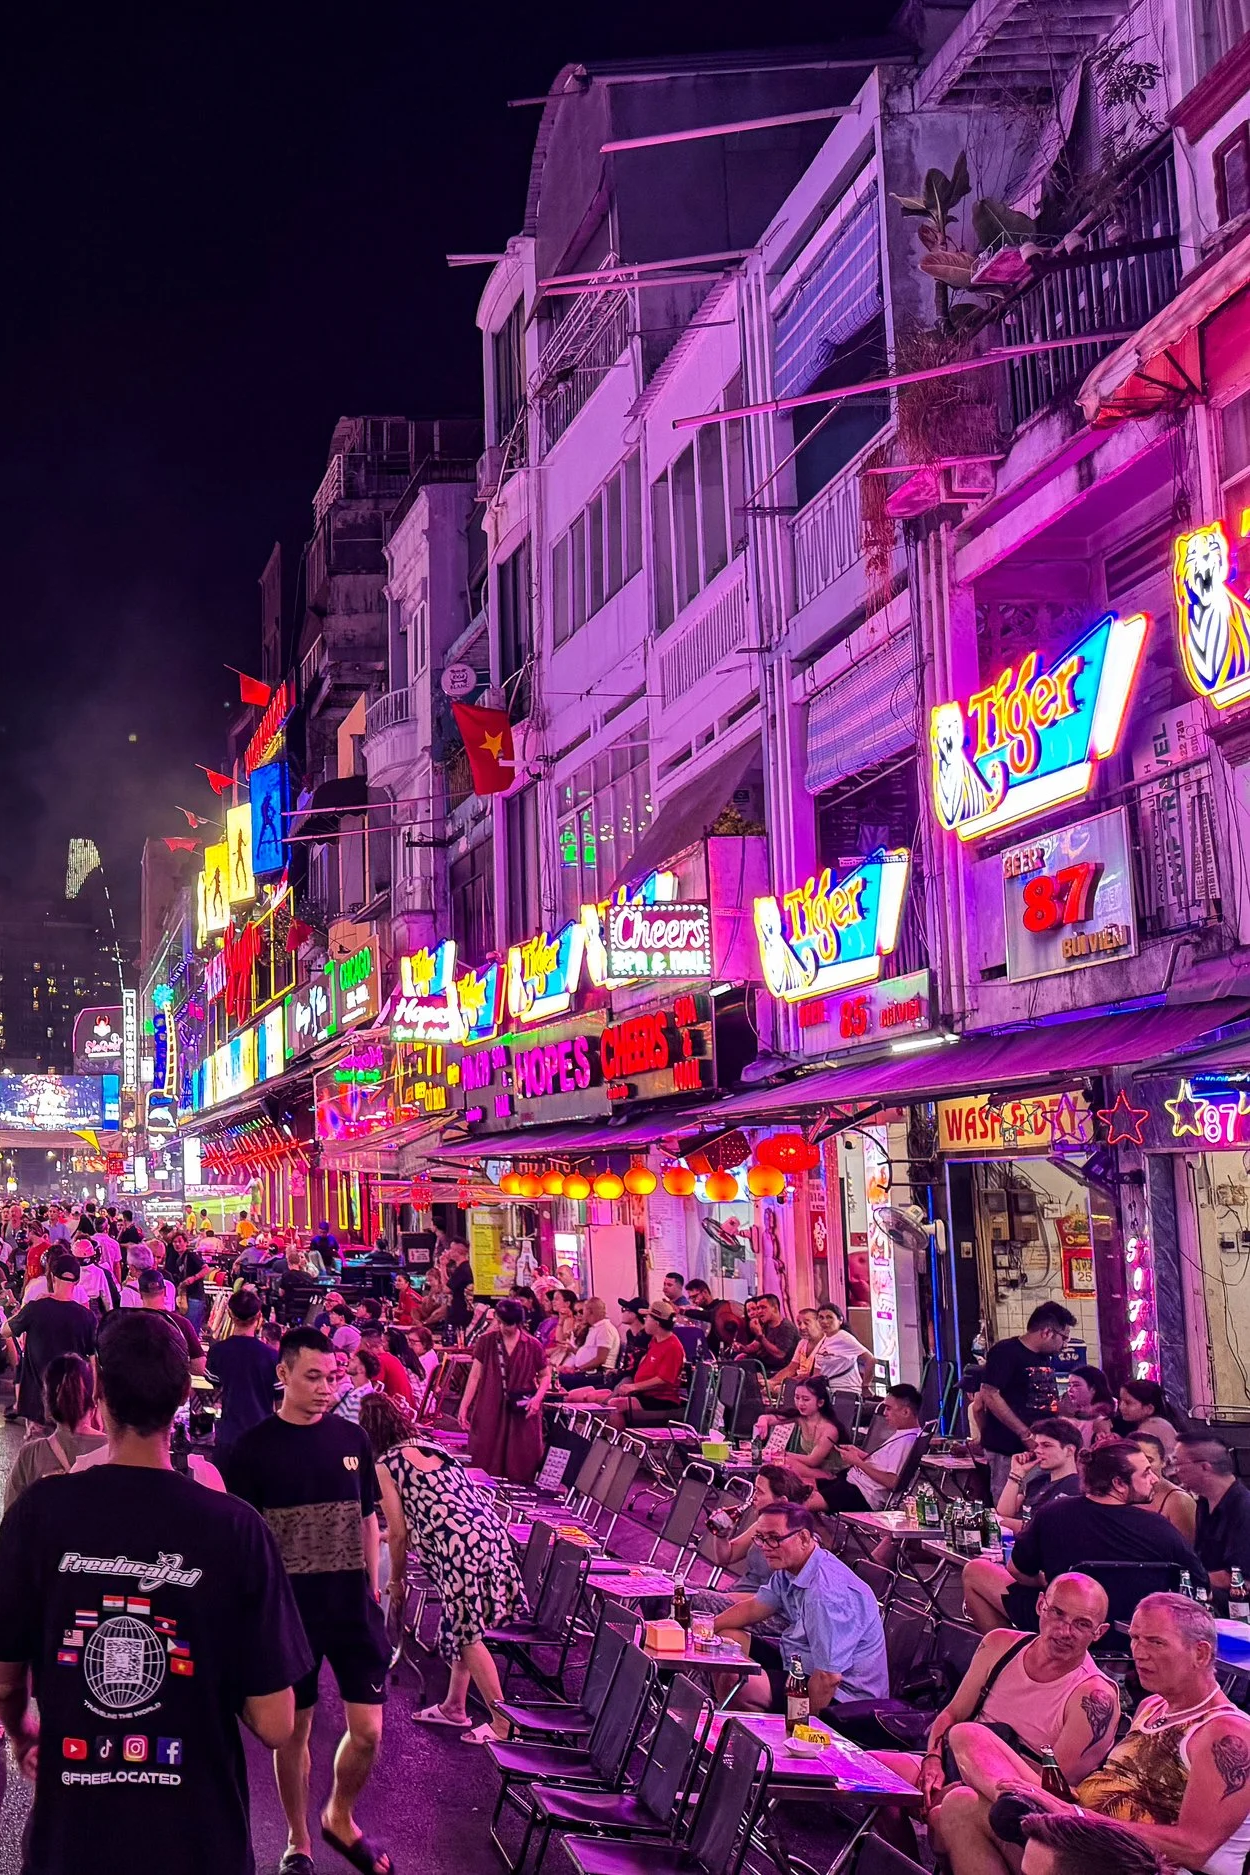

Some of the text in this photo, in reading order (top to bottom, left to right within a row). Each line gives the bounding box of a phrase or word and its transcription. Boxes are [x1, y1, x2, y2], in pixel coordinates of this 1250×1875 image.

[967, 652, 1081, 776] Tiger
[1003, 847, 1044, 880] BEER
[783, 867, 864, 962] Tiger
[1022, 861, 1094, 933] 87
[615, 908, 706, 950] Cheers
[339, 946, 371, 991] CHICAGO
[521, 931, 561, 995] Tiger
[673, 993, 698, 1029] SPA
[840, 995, 867, 1039] 85
[515, 1035, 591, 1098] HOPES
[601, 1010, 669, 1082] CHEERS
[673, 1058, 703, 1092] NAIL
[944, 1106, 1003, 1145] WASH
[1203, 1103, 1238, 1143] 87
[1077, 1271, 1093, 1283] 25
[58, 1551, 203, 1590] Freelocated
[133, 1702, 162, 1717] WORLD
[61, 1769, 182, 1787] @FREELOCATED
